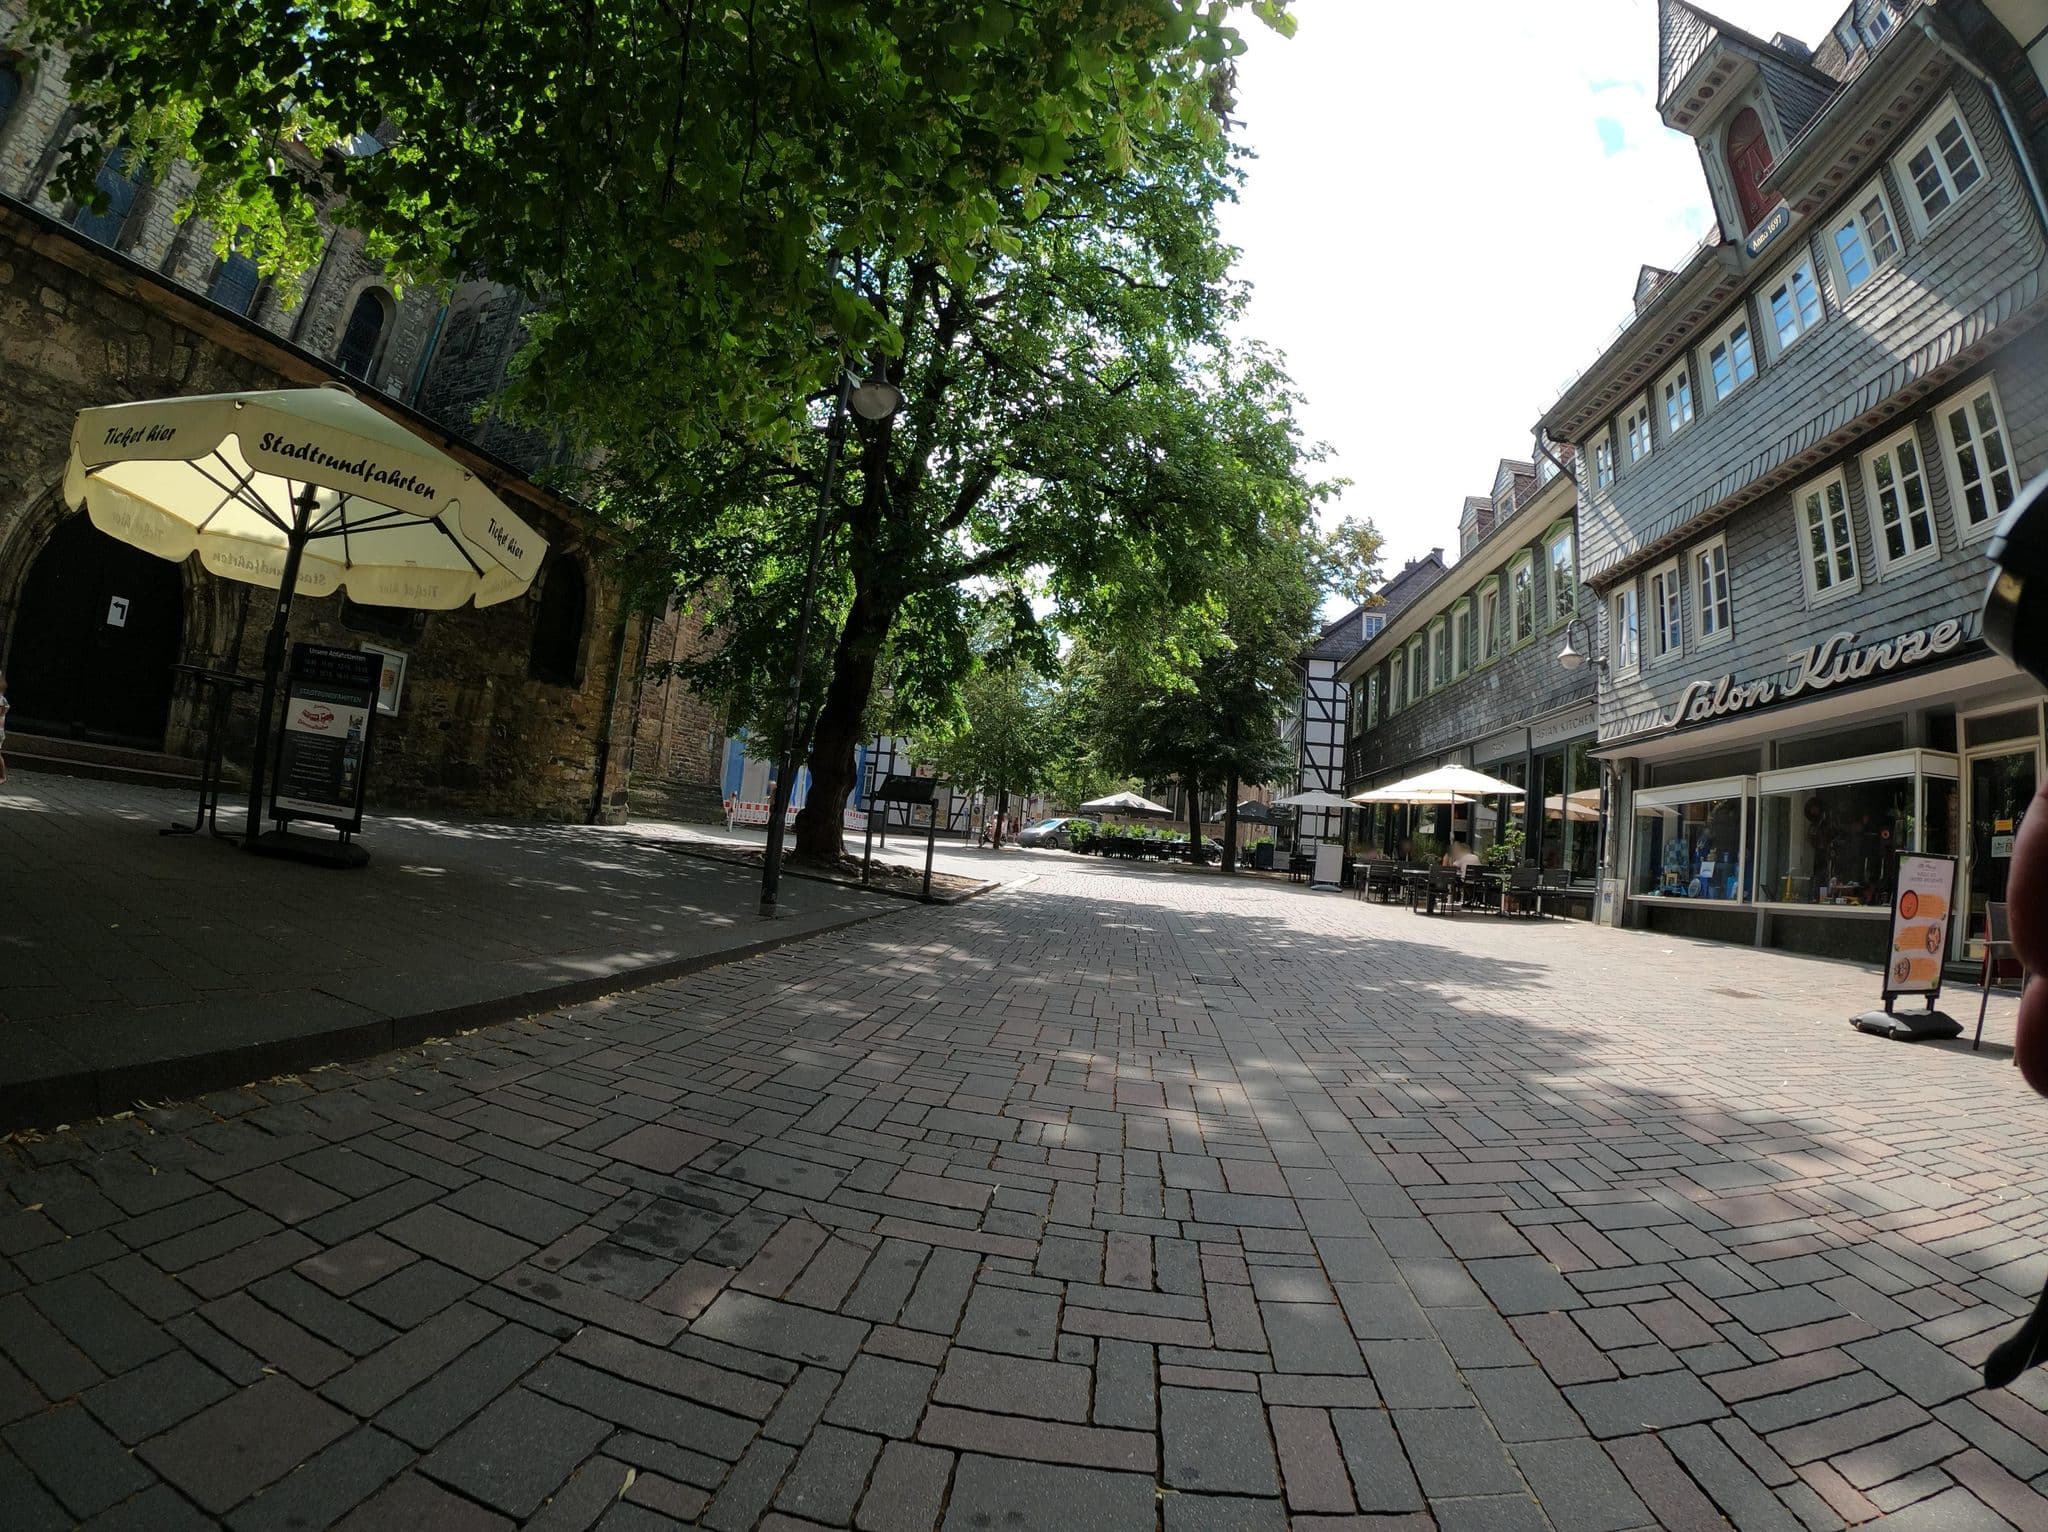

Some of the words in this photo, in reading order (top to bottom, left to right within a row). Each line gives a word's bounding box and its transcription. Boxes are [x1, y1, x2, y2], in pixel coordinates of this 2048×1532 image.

[1752, 231, 1768, 250] Anno
[1767, 214, 1782, 233] 1697
[103, 425, 147, 448] Ticket
[145, 424, 177, 442] hier
[259, 432, 436, 500] Stadtrundfahrten
[487, 517, 510, 547] Ticket
[506, 537, 524, 560] hier
[1660, 673, 1775, 729] Salon
[1782, 618, 1963, 698] Kunze
[1560, 712, 1596, 732] KITCHEN
